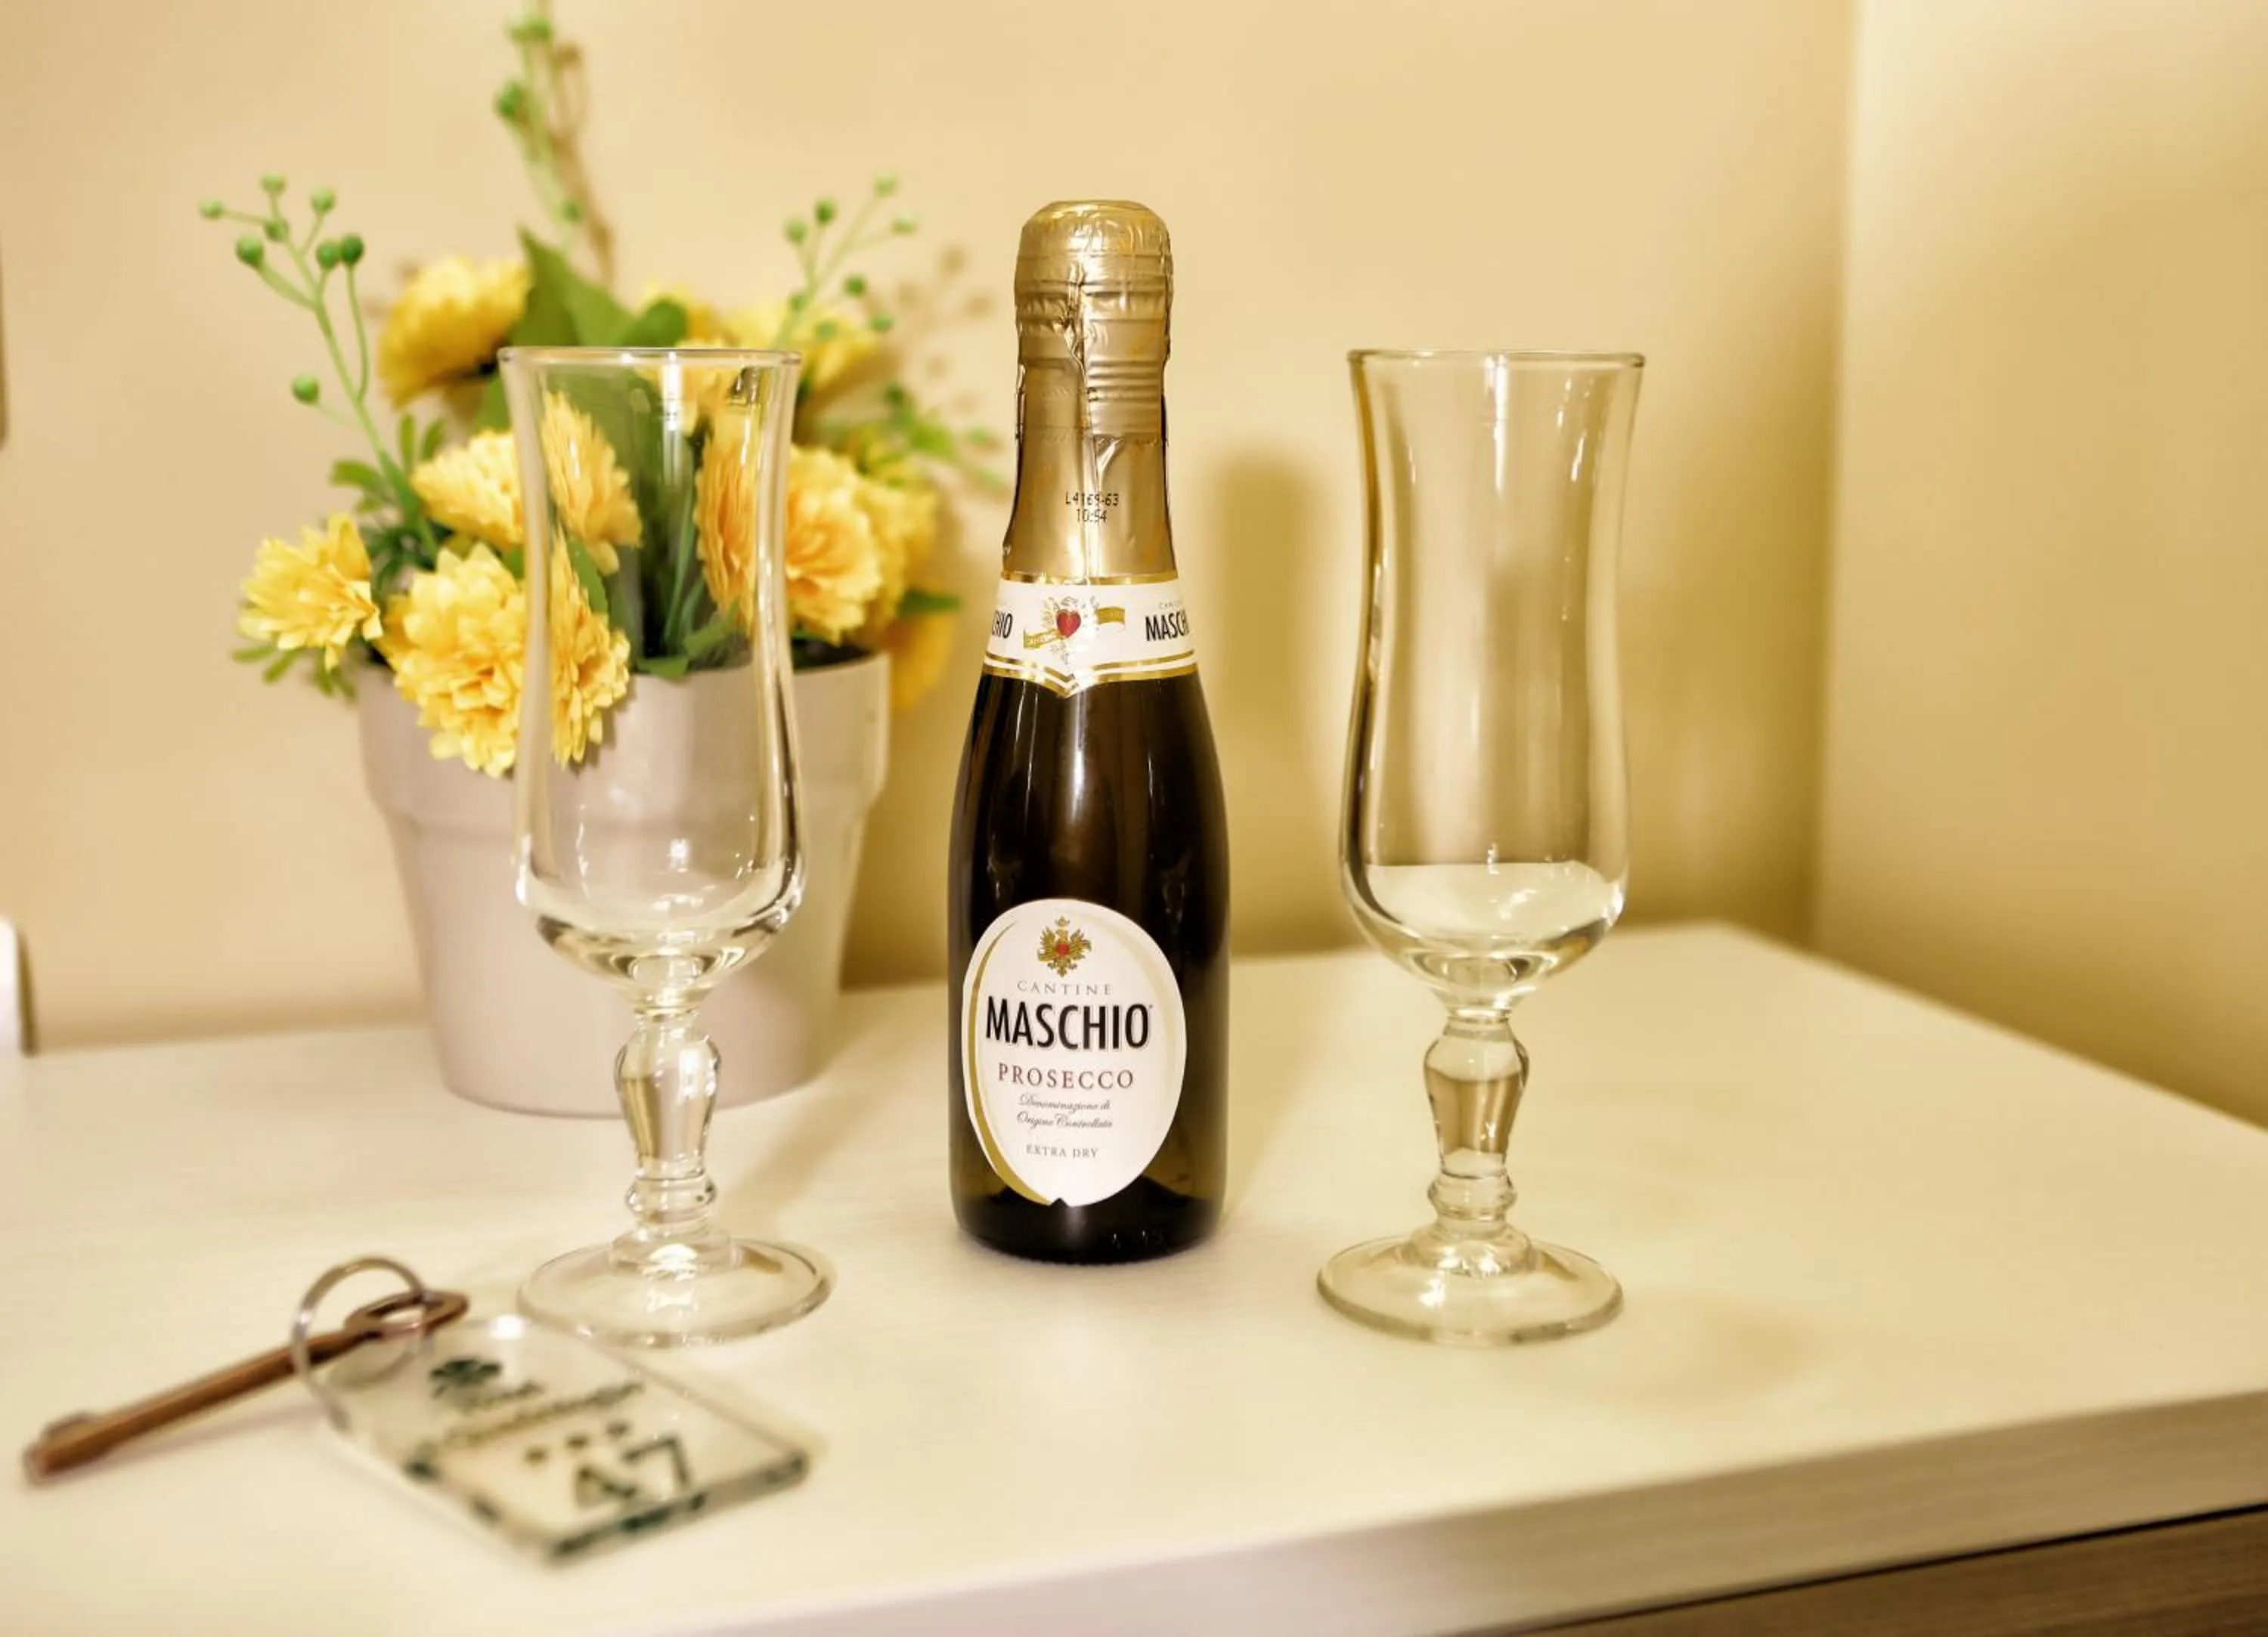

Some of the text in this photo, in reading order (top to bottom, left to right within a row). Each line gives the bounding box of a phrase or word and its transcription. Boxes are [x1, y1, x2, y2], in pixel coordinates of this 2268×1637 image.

[1017, 980, 1111, 995] CANTINE
[986, 995, 1149, 1050] MASCHIO
[998, 1063, 1133, 1089] PROSECCO
[1026, 1144, 1098, 1159] EXTRA DRY
